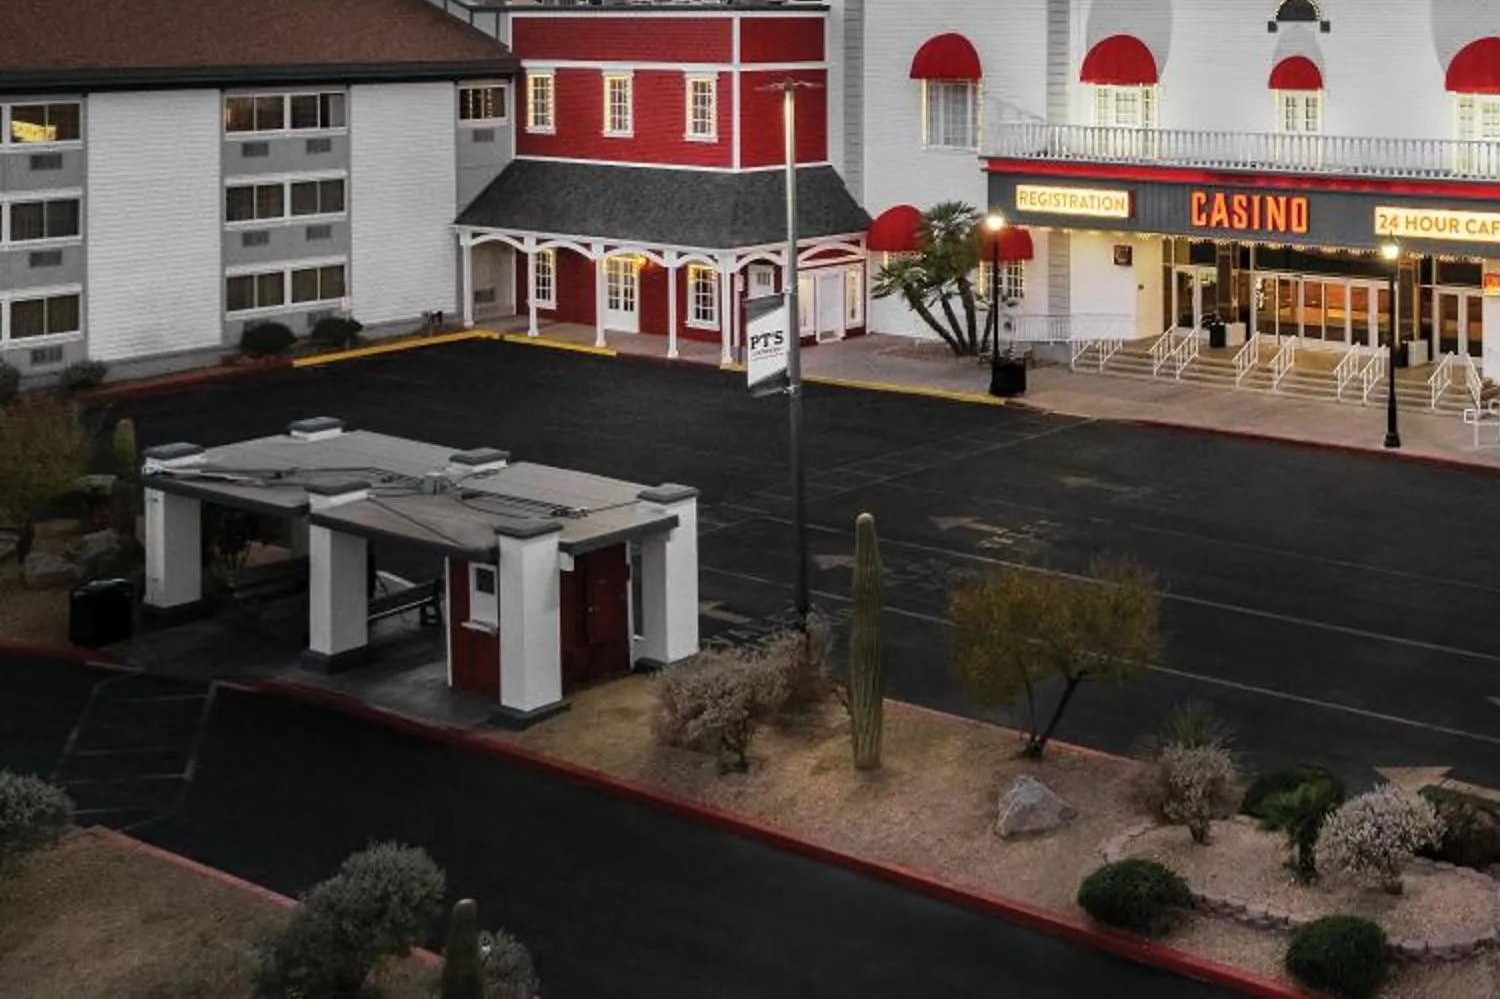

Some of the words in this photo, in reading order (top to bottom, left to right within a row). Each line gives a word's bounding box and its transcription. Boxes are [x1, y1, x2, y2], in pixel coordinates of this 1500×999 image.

[1018, 190, 1126, 211] REGISTRATION
[1191, 191, 1308, 233] CASINO
[1379, 214, 1400, 230] 24
[1405, 216, 1460, 234] HOUR
